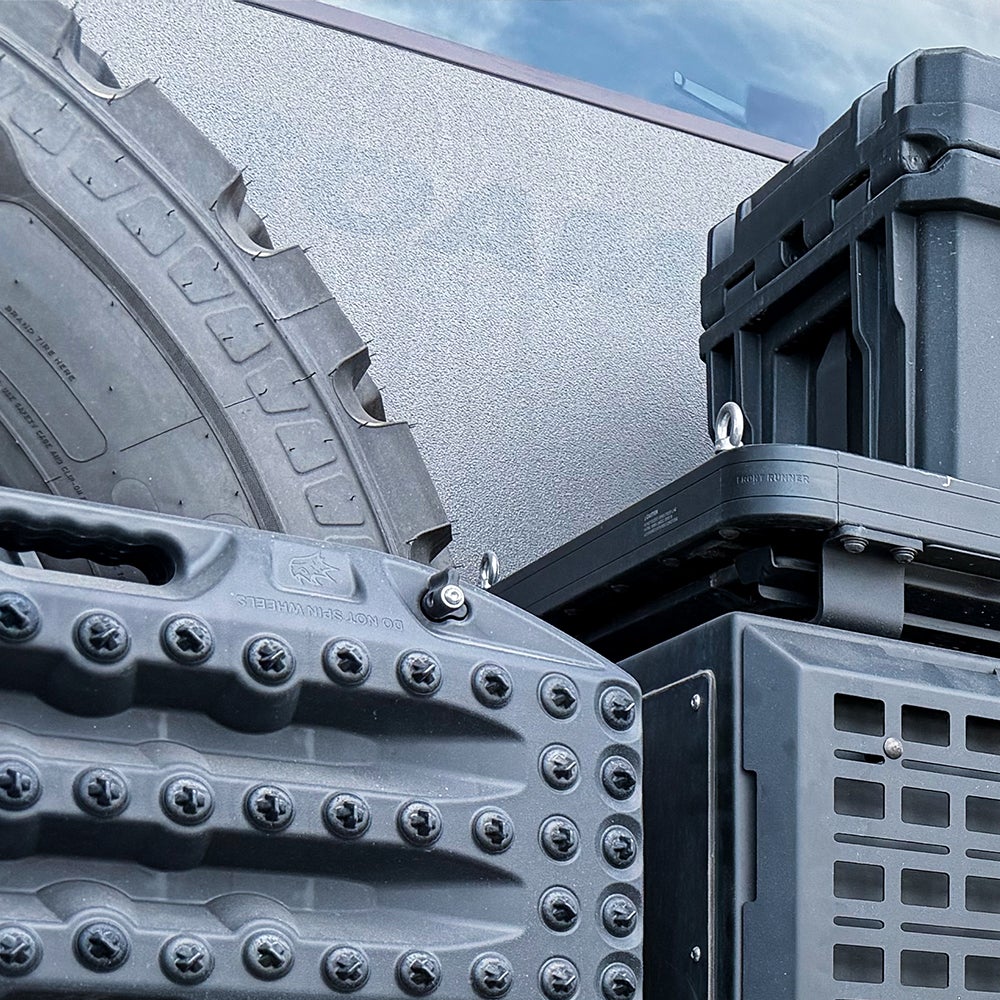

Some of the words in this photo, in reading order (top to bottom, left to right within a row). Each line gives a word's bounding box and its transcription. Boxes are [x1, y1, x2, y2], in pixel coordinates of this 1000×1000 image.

[54, 358, 76, 382] HERE
[766, 472, 810, 484] RUNNER
[235, 594, 305, 616] WHEELS
[307, 604, 343, 622] SPIN
[346, 612, 379, 628] NOT
[382, 617, 404, 632] DO
